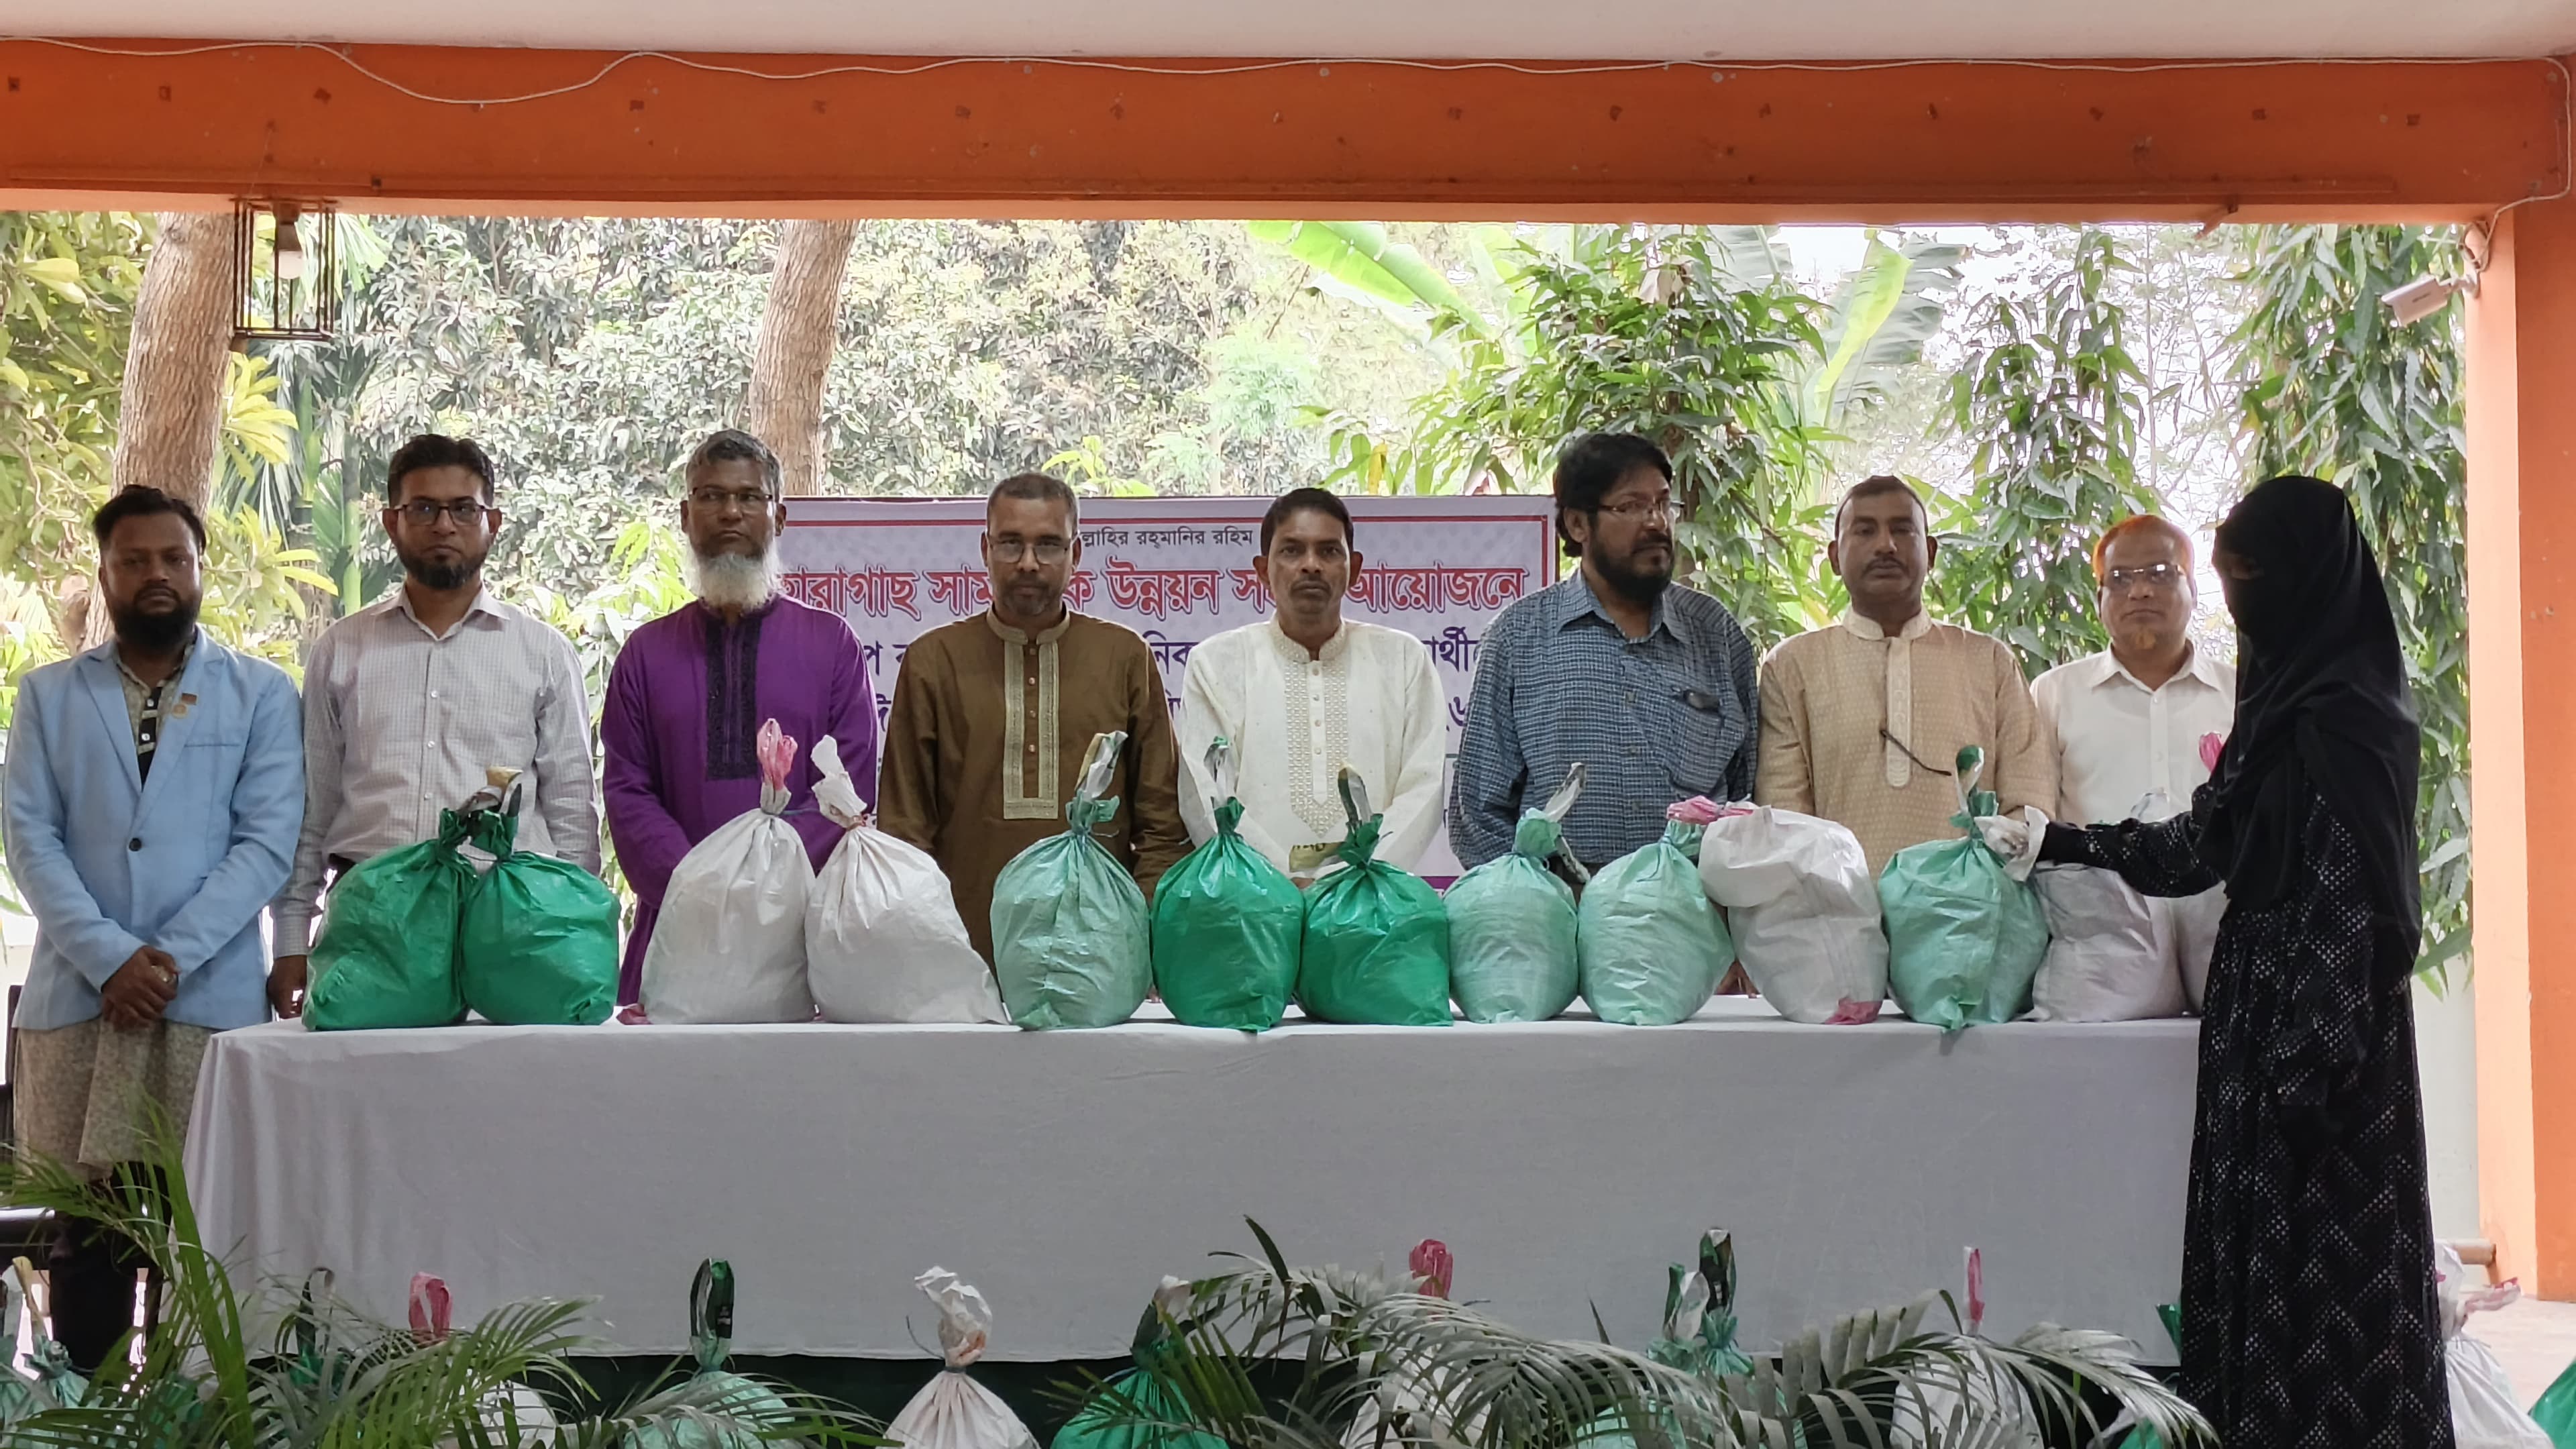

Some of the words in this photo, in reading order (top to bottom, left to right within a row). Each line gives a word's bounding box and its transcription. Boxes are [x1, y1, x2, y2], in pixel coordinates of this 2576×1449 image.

[1080, 526, 1128, 547] ল্লাহির
[1212, 525, 1253, 547] রহিম
[1102, 555, 1224, 621] উন্নয়ন
[1346, 561, 1529, 614] আয়োজনে
